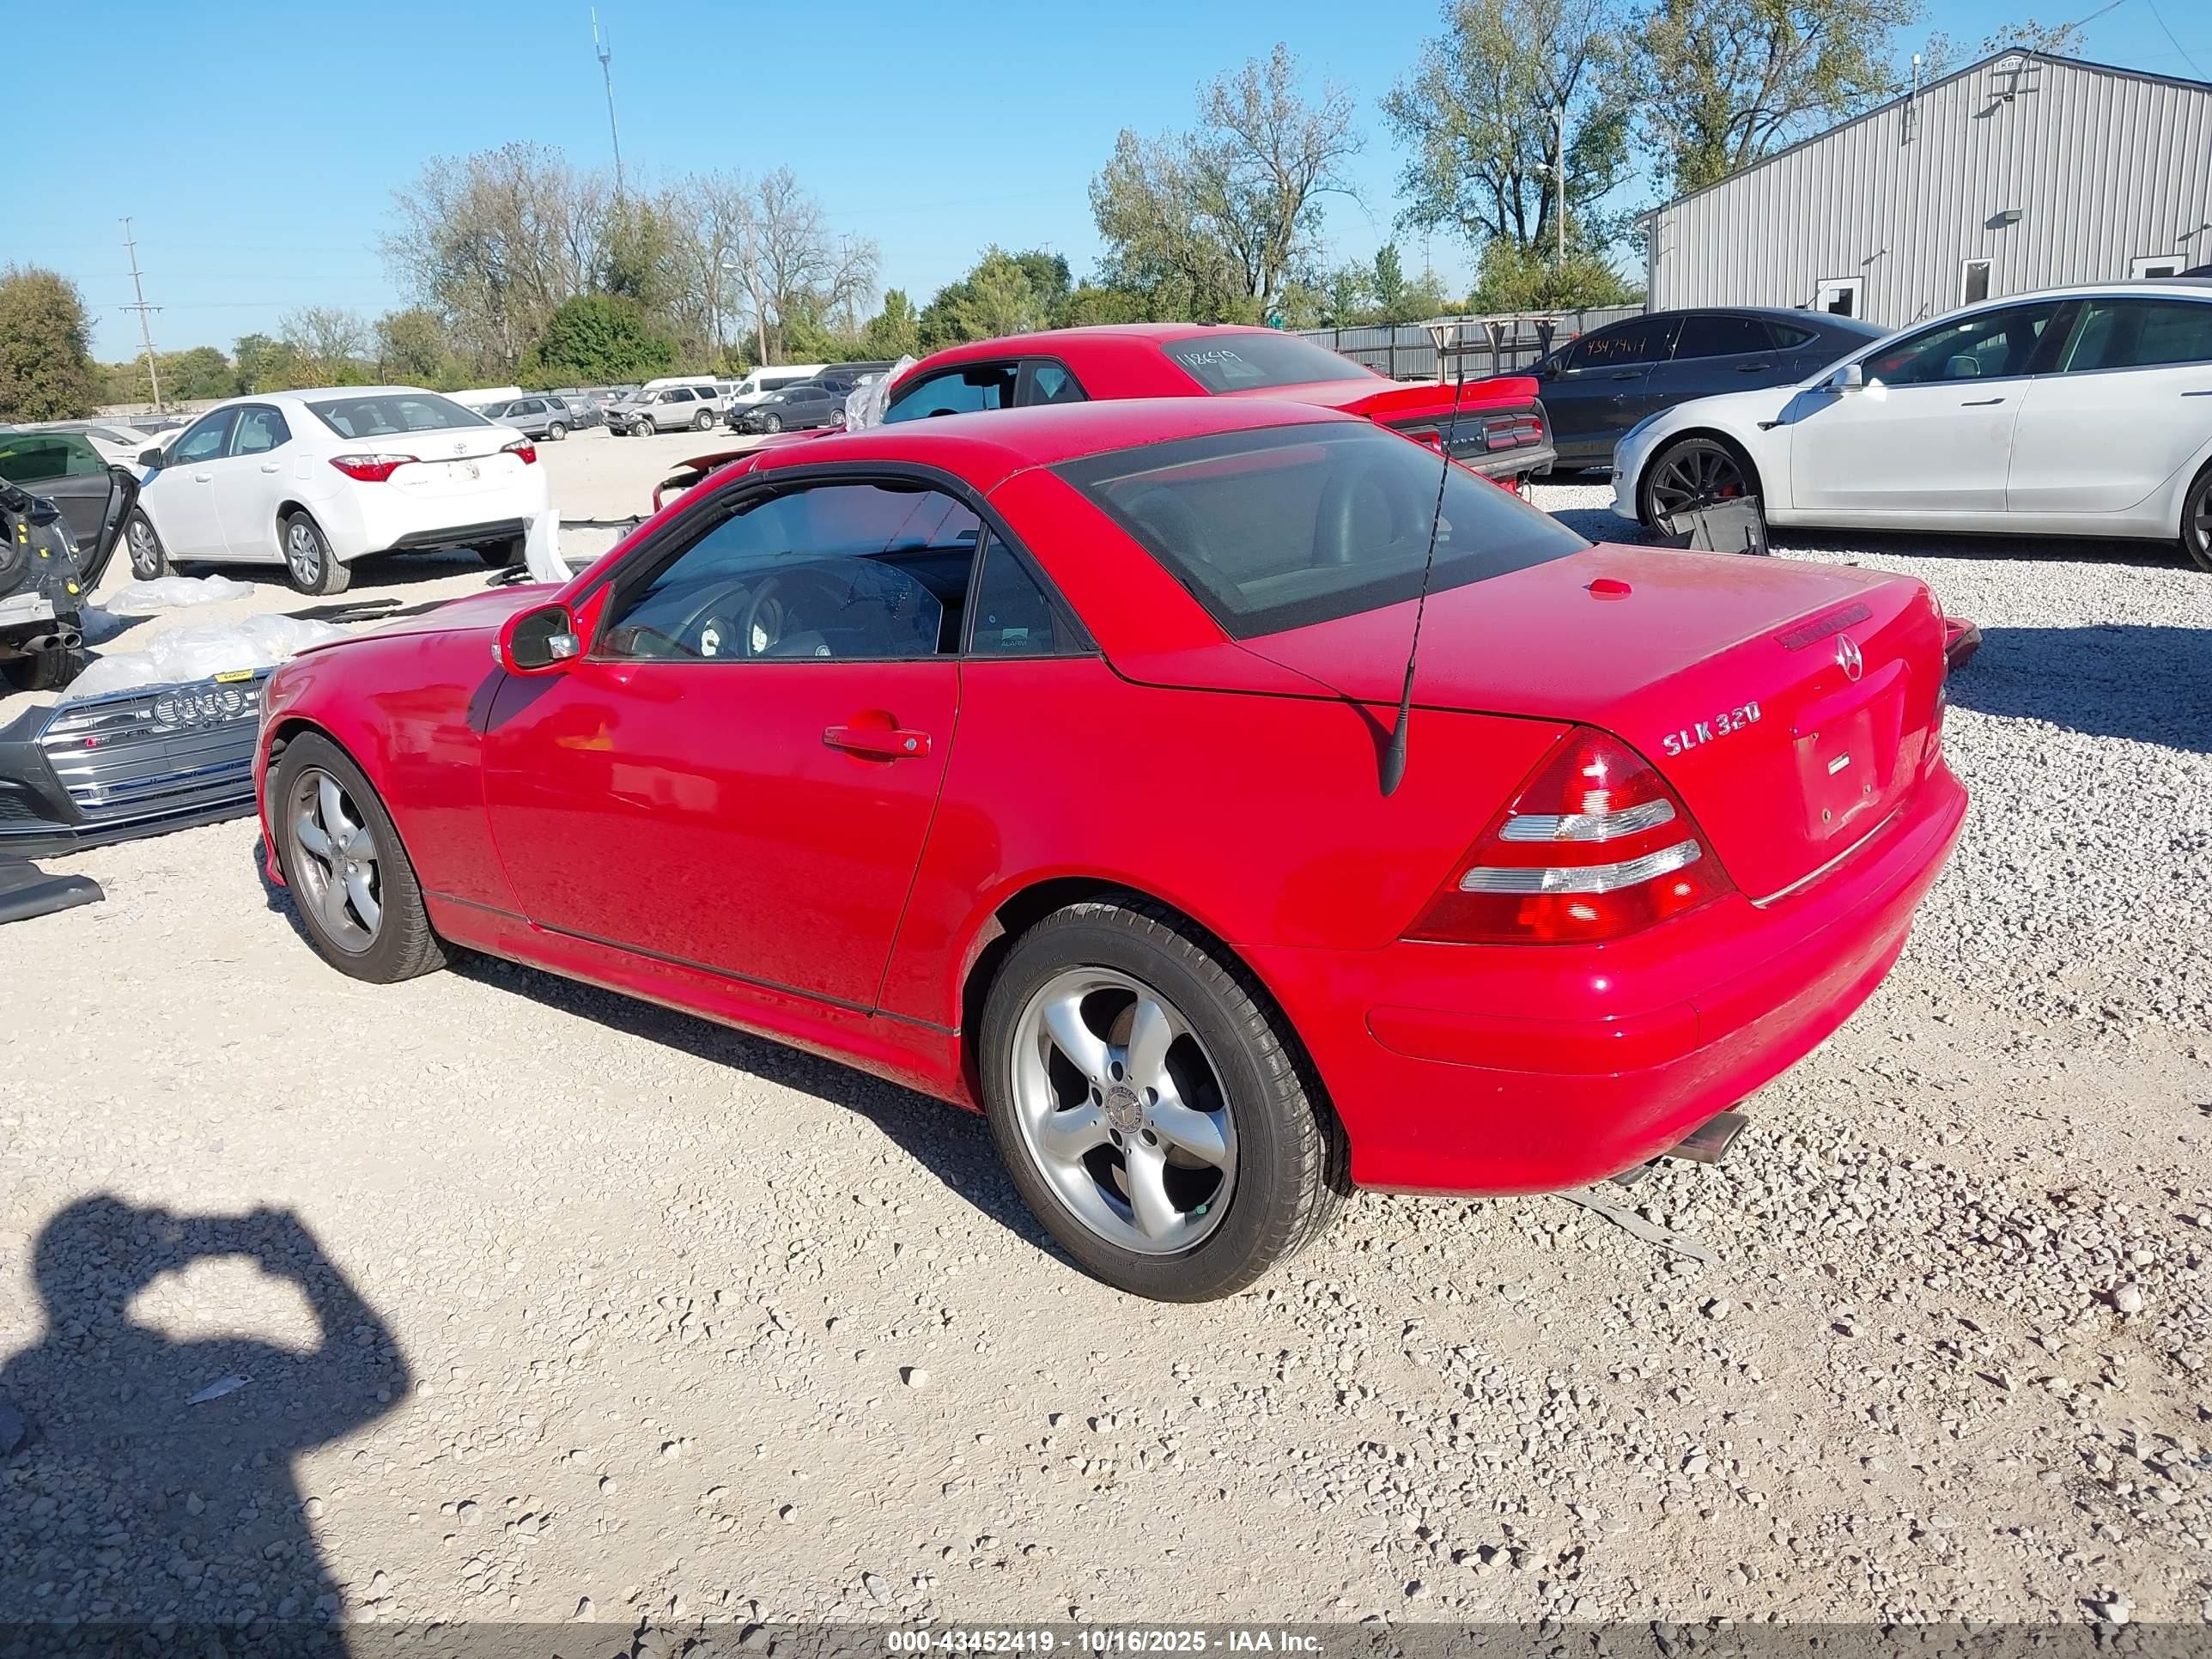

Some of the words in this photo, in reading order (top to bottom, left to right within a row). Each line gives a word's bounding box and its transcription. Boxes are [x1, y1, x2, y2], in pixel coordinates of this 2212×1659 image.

[1176, 349, 1243, 366] 118649
[1662, 720, 1714, 757] SLK
[1716, 701, 1761, 736] 320
